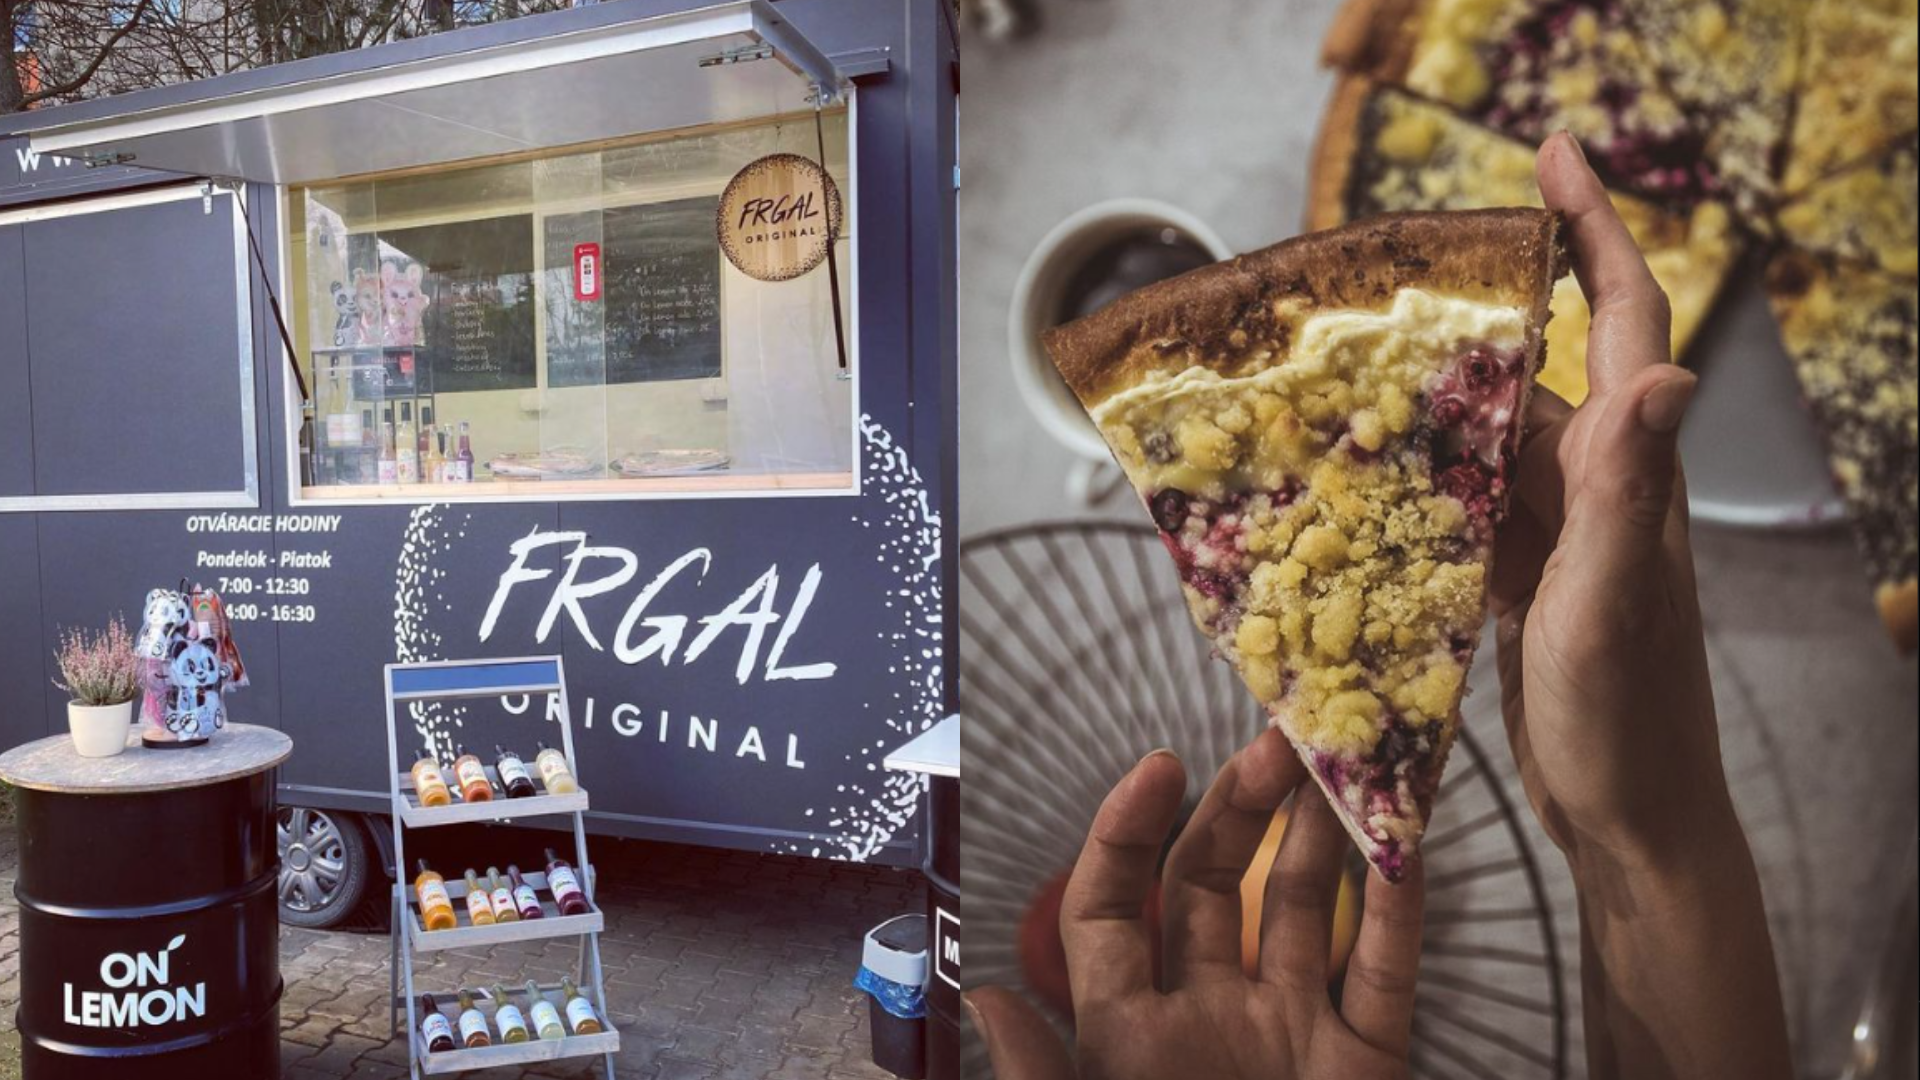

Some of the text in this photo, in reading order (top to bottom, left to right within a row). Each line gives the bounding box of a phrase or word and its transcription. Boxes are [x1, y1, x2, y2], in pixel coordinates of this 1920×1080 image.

[738, 190, 819, 230] FRGAL
[745, 226, 815, 244] ORIGINAL
[186, 512, 342, 533] OTVÁRACIE HODINY
[196, 550, 267, 568] Pondelok
[280, 550, 332, 568] Piatok
[218, 577, 252, 594] 7:00
[265, 578, 309, 595] 12:30
[225, 604, 258, 621] 4:00
[271, 605, 315, 621] 16:30
[479, 524, 838, 685] FRGAL
[501, 692, 805, 769] ORIGINAL
[100, 949, 169, 988] ON
[63, 981, 206, 1028] LEMON
